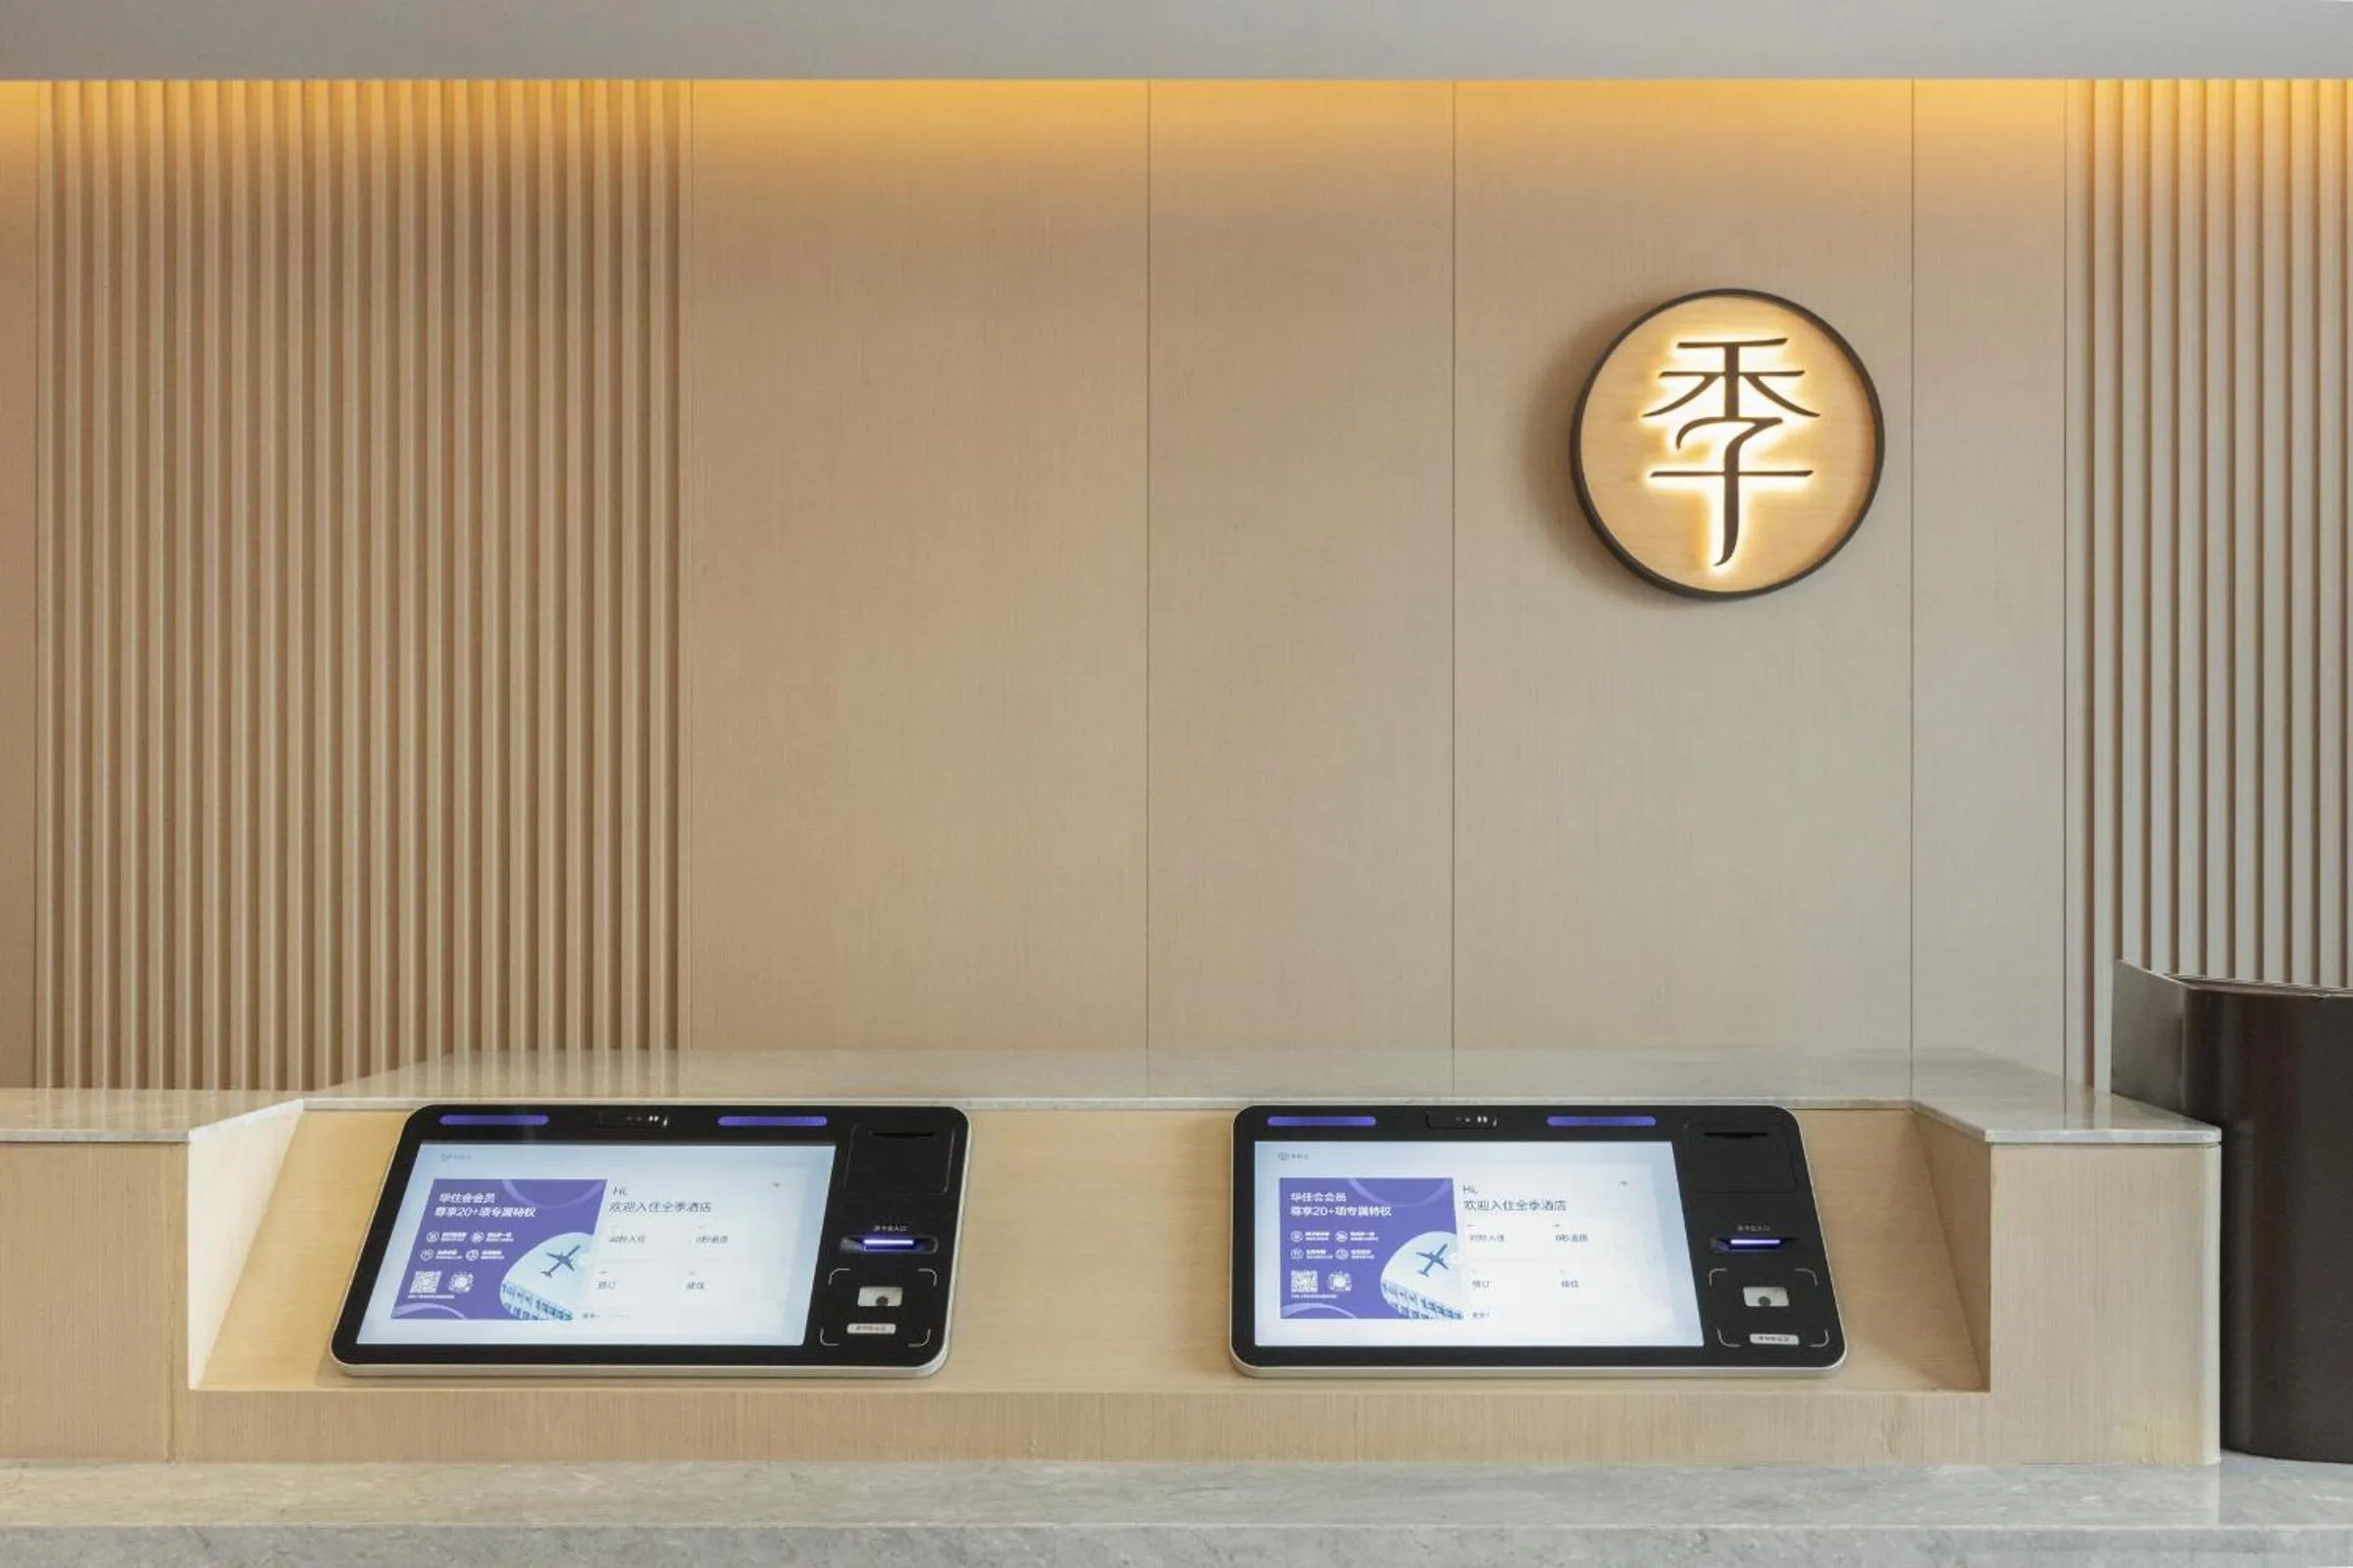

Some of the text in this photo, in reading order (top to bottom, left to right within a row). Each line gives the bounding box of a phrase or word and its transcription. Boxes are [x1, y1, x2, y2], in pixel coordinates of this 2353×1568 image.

[1641, 337, 1820, 566] 季
[608, 1201, 713, 1213] 欢迎入住全季酒店
[1463, 1199, 1567, 1212] 欢迎入住全季酒店
